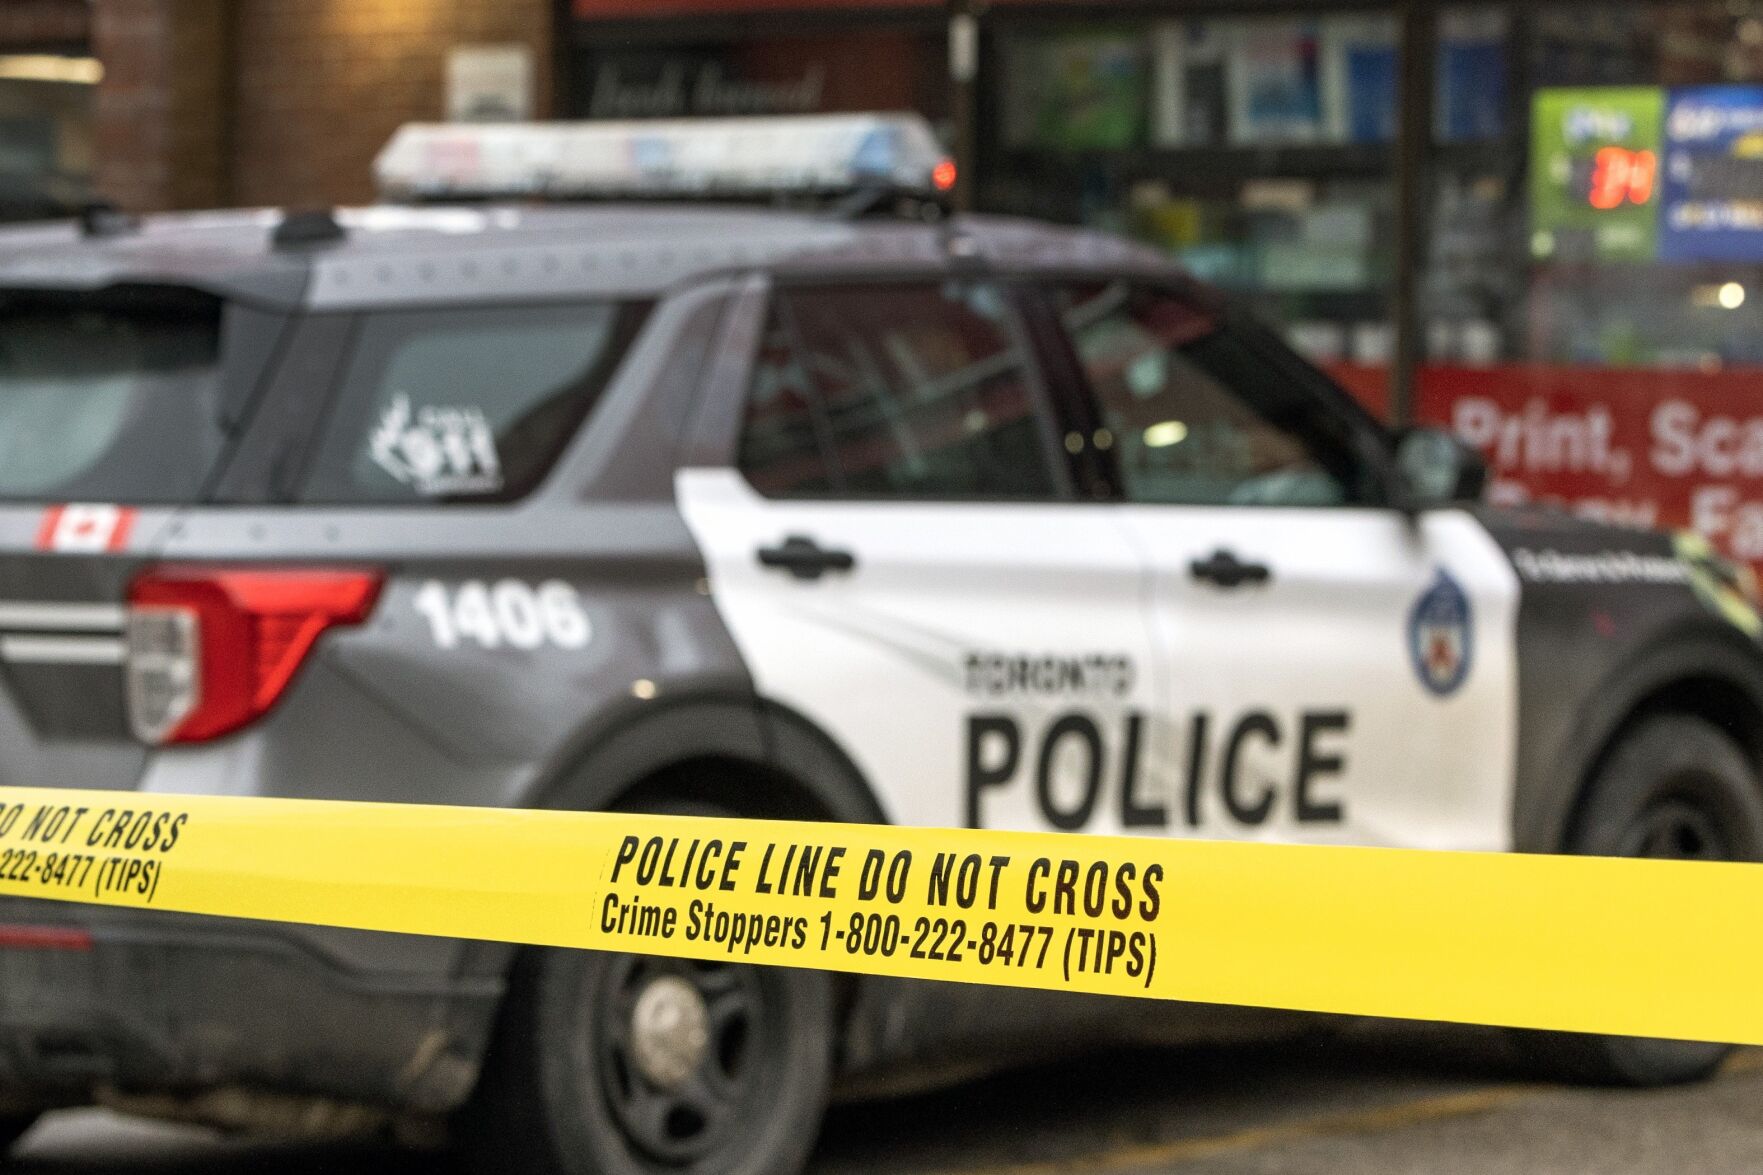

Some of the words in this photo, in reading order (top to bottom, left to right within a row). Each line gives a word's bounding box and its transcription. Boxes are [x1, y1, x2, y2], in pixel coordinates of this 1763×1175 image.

[1453, 396, 1634, 485] Print,
[414, 577, 591, 650] 1406
[963, 652, 1136, 695] TORONTO
[965, 709, 1351, 832] POLICE
[22, 806, 89, 844] NOT
[86, 808, 188, 853] CROSS
[95, 856, 162, 903] (TIPS)
[610, 835, 747, 892] POLICE
[755, 843, 847, 899] LINE
[858, 848, 912, 904] DO
[927, 852, 1011, 910] NOT
[1025, 857, 1164, 922] CROSS
[600, 892, 677, 939] Crime
[685, 898, 808, 955] Stoppers
[820, 910, 1054, 969] 1-800-222-8477
[1063, 927, 1157, 988] (TIPS)
